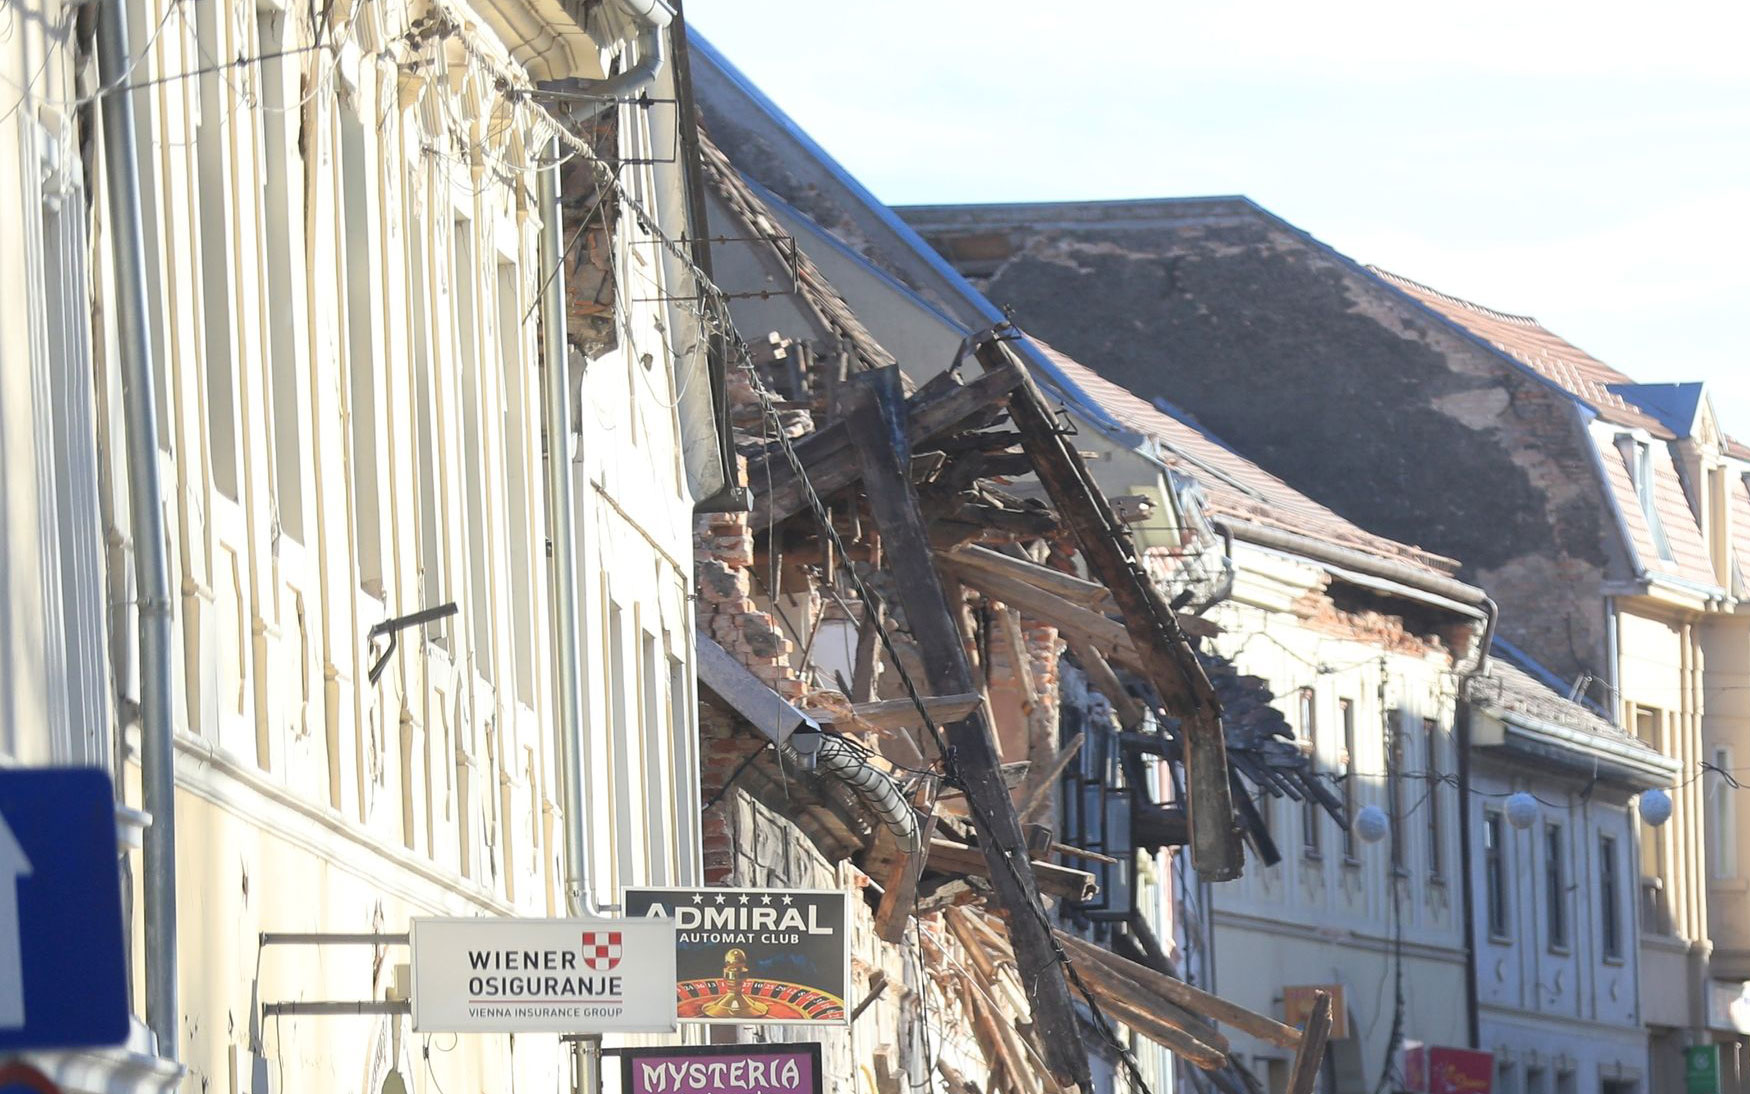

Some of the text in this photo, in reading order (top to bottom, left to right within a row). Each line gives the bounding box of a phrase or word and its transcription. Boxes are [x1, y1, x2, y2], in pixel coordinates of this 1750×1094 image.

[644, 902, 834, 935] ADMIRAL
[679, 932, 800, 944] AUTOMAT CLUB
[468, 950, 576, 970] WIENER
[469, 976, 622, 996] OSIGURANJE
[469, 1007, 623, 1018] VIENNA INSURANCE GROUP
[641, 1058, 801, 1093] MYSTERIA
